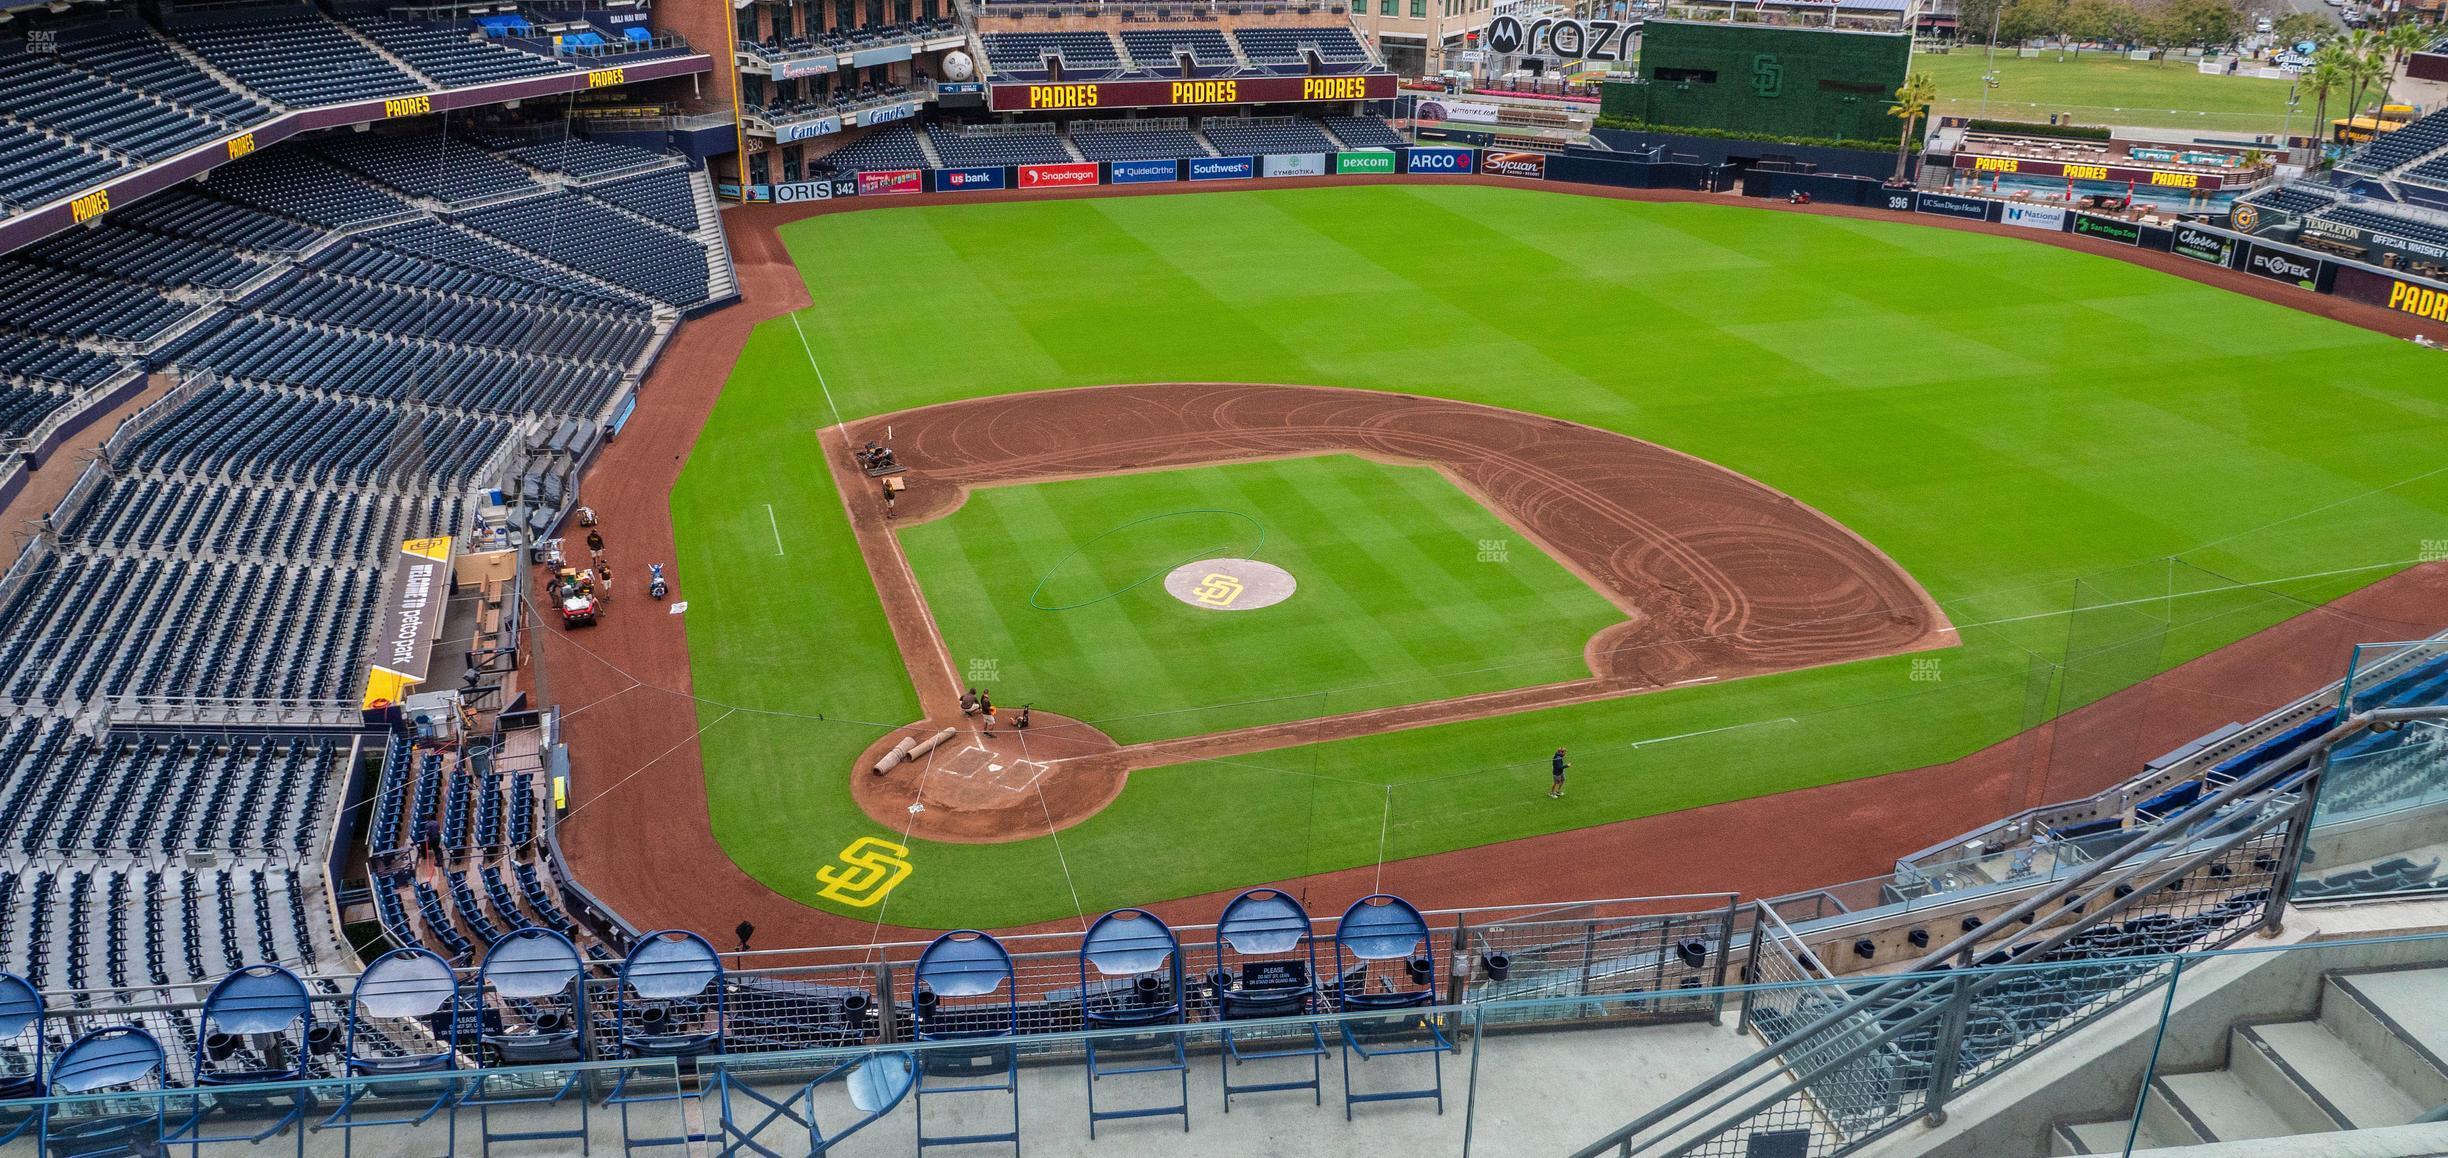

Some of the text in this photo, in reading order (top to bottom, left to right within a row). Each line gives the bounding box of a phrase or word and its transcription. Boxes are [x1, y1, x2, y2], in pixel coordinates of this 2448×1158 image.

[589, 69, 624, 87] PADRES
[1030, 84, 1098, 108] PADRES
[1172, 80, 1236, 104] PADRES
[1304, 77, 1365, 99] PADRES
[386, 96, 430, 118] PADRES
[228, 133, 255, 159] PADRES
[1193, 163, 1243, 174] Southwest
[1410, 154, 1454, 168] ARCO
[1485, 152, 1538, 174] Sycuan
[1975, 157, 2018, 172] PADRES
[965, 173, 990, 183] bank
[1041, 170, 1094, 181] Snapdragon
[2062, 164, 2108, 180] PADRES
[2151, 172, 2198, 188] PADRES
[778, 183, 830, 200] ORIS
[836, 182, 854, 195] 342
[72, 189, 109, 223] PADRES
[1889, 196, 1908, 209] 396
[1945, 201, 1961, 211] Diego
[1962, 204, 1981, 213] Health
[2024, 210, 2060, 220] National
[2090, 223, 2137, 238] San Diego Zoo
[2305, 218, 2361, 239] TEMPLETON
[2179, 230, 2220, 250] Chosen
[2372, 234, 2445, 258] OFFICIAL WHISKEY
[2388, 281, 2448, 323] PADR
[392, 564, 433, 665] WELCOME TO petco park
